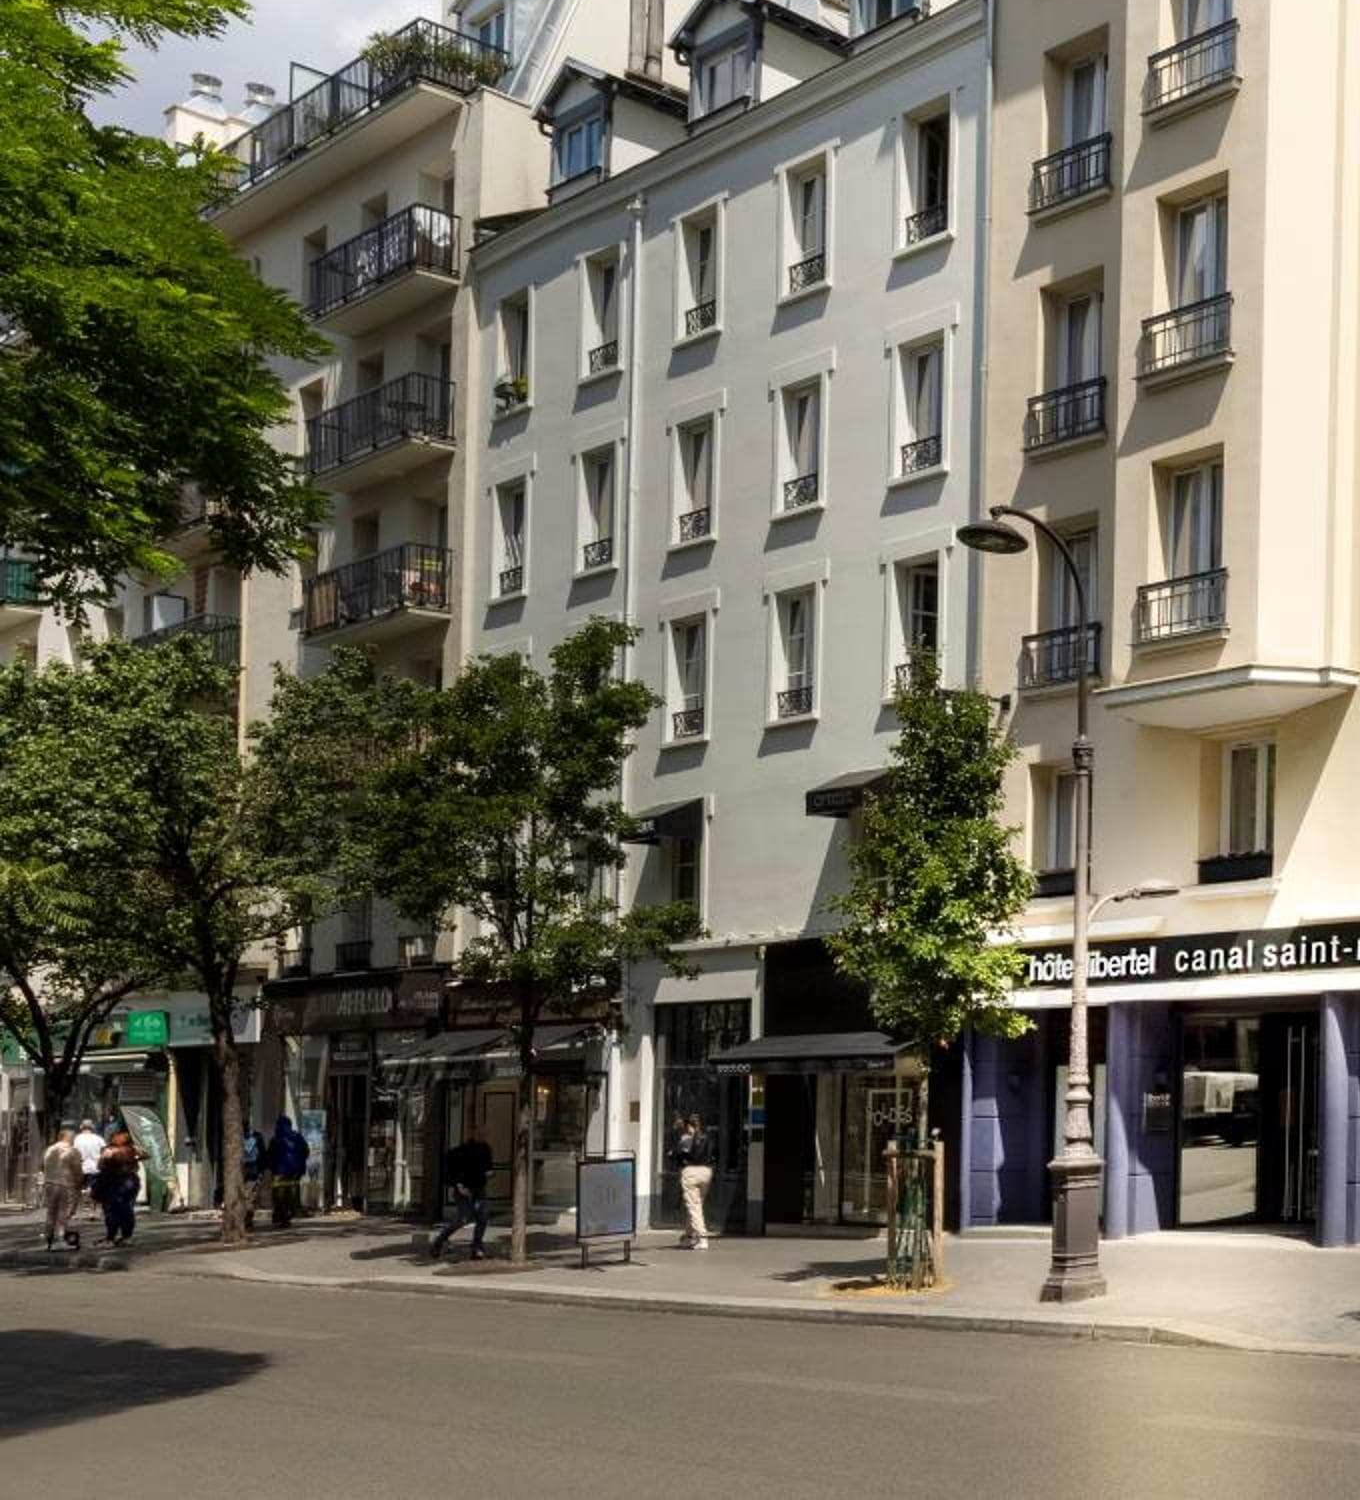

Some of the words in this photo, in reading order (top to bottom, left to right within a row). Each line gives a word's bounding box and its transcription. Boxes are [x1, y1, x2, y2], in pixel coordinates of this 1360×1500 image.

[1029, 953, 1077, 982] hôte
[1083, 946, 1158, 979] ibertel
[1174, 939, 1254, 972] canal
